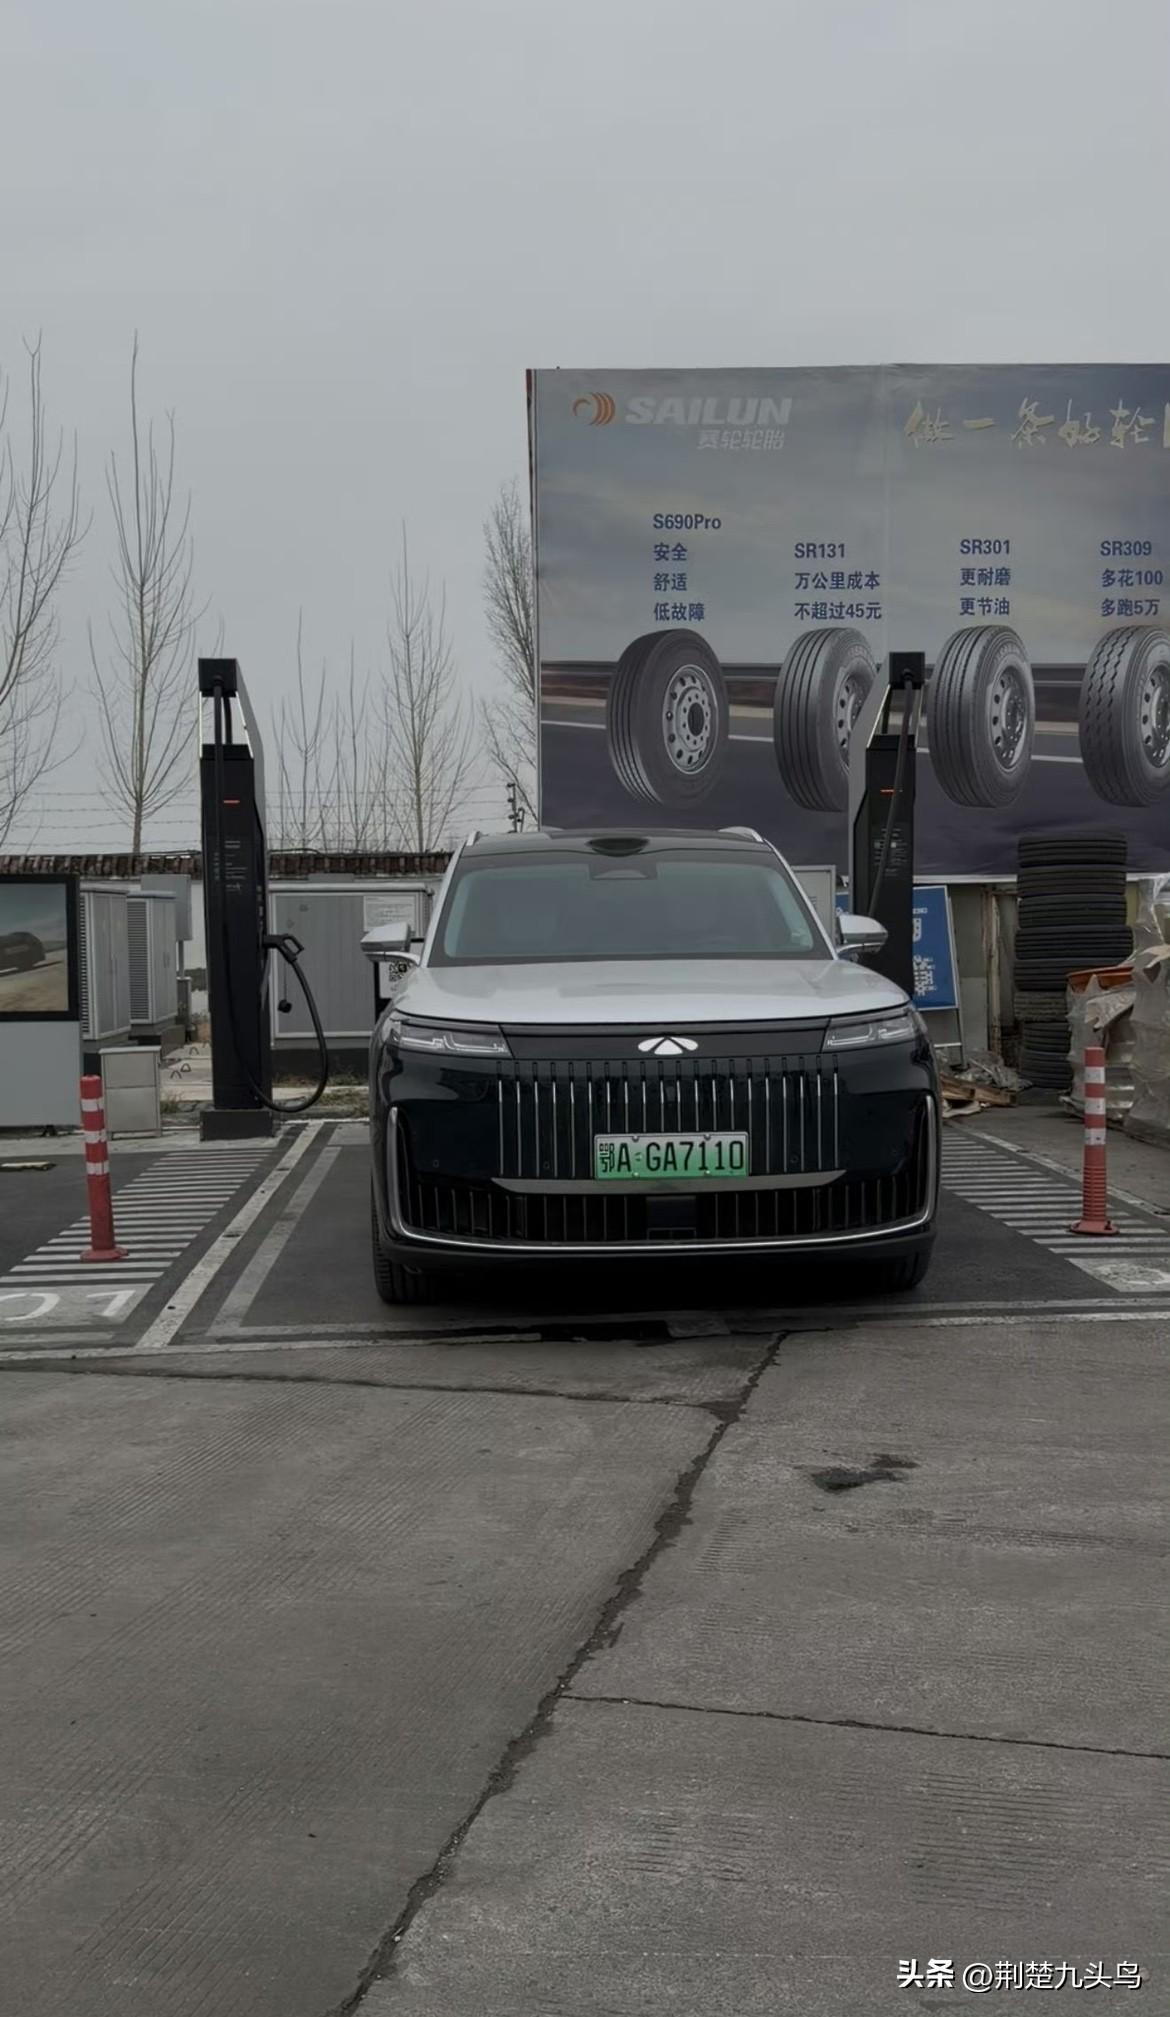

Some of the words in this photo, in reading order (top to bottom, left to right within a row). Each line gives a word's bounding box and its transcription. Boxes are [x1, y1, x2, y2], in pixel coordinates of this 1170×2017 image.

[625, 398, 793, 425] SAILUN
[697, 429, 785, 451] 赛轮轮胎
[653, 514, 721, 530] S690Pro
[653, 543, 688, 562] 安全
[794, 543, 846, 559] SR131
[960, 539, 1011, 555] SR301
[1100, 540, 1152, 556] SR309
[653, 572, 688, 592] 舒适
[794, 571, 880, 591] 万公里成本
[960, 567, 1011, 587] 更耐磨
[1102, 568, 1163, 588] 多花100
[653, 602, 705, 622] 低故障
[794, 602, 882, 622] 不超过45元
[960, 597, 1010, 616] 更节油
[1101, 598, 1160, 617] 多跑5万
